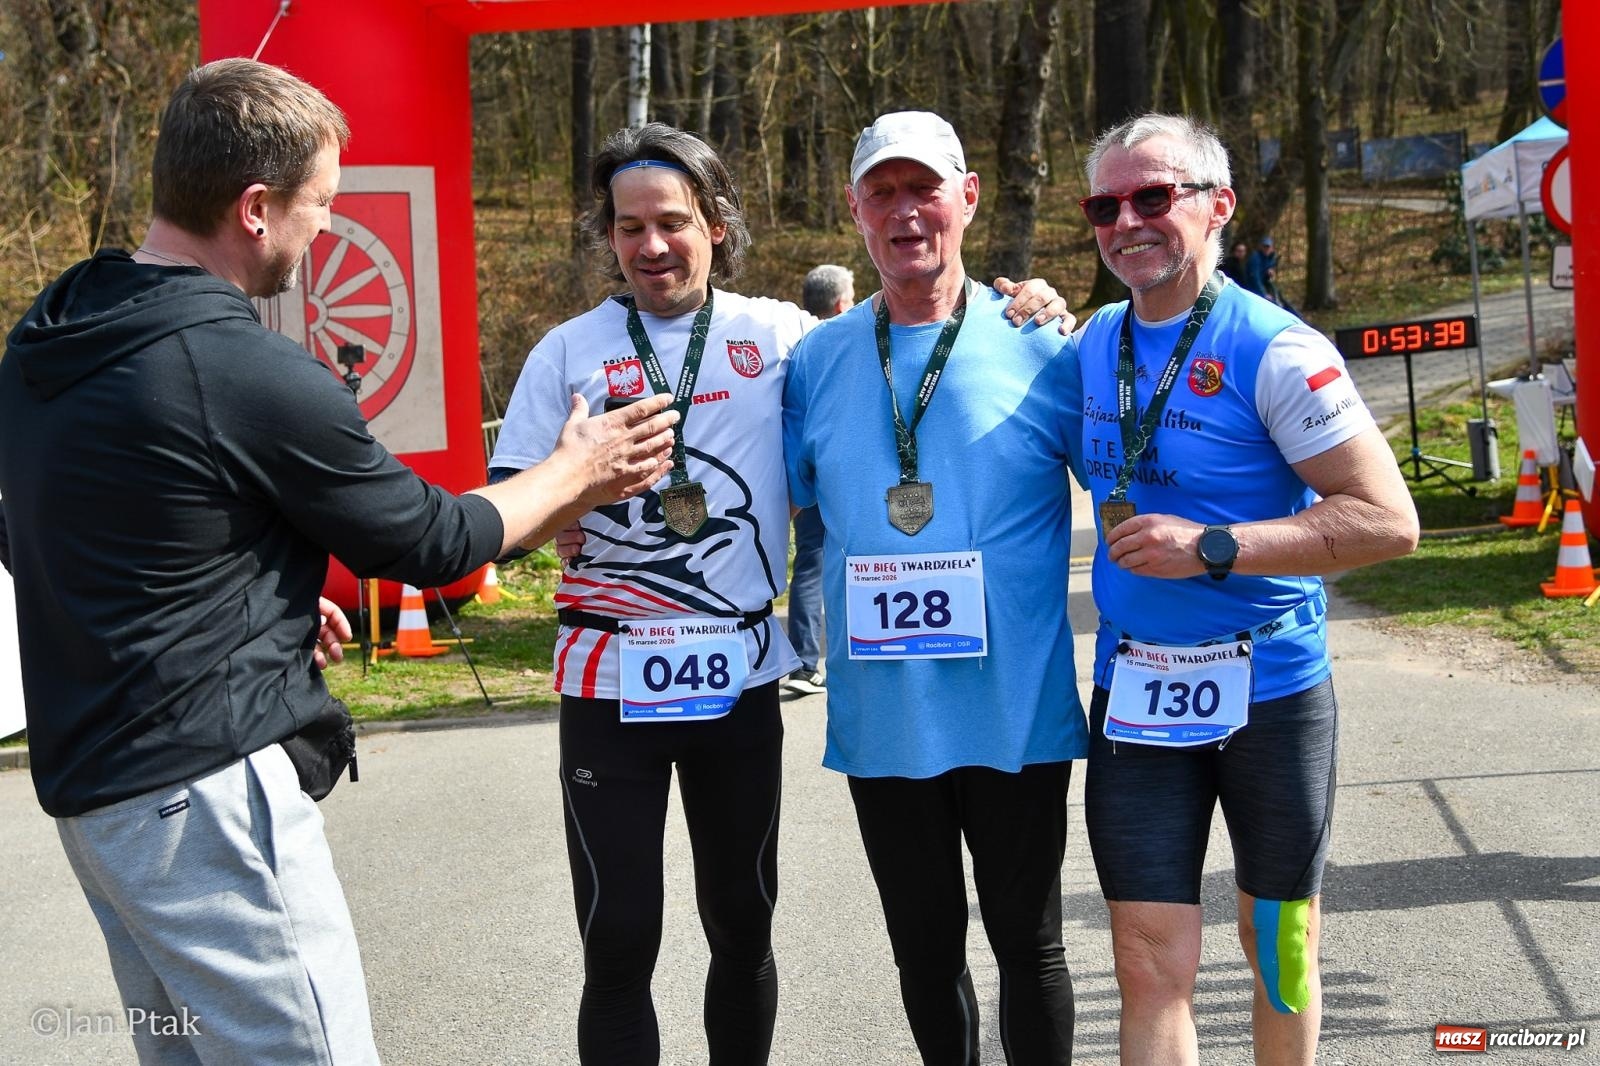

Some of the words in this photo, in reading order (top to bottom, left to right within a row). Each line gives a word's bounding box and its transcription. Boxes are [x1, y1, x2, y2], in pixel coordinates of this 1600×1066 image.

[1363, 321, 1465, 353] 0:53:39
[854, 563, 870, 573] XIV
[873, 562, 897, 573] BIEG
[901, 559, 972, 572] TWARDZIELA
[873, 590, 952, 629] 128
[628, 627, 646, 638] XIV
[649, 626, 675, 637] BIEG
[679, 624, 737, 636] TWARDZIELA
[1127, 646, 1143, 659] XIV
[1146, 650, 1168, 664] BIEG
[643, 653, 730, 692] 048
[1144, 679, 1221, 718] 130
